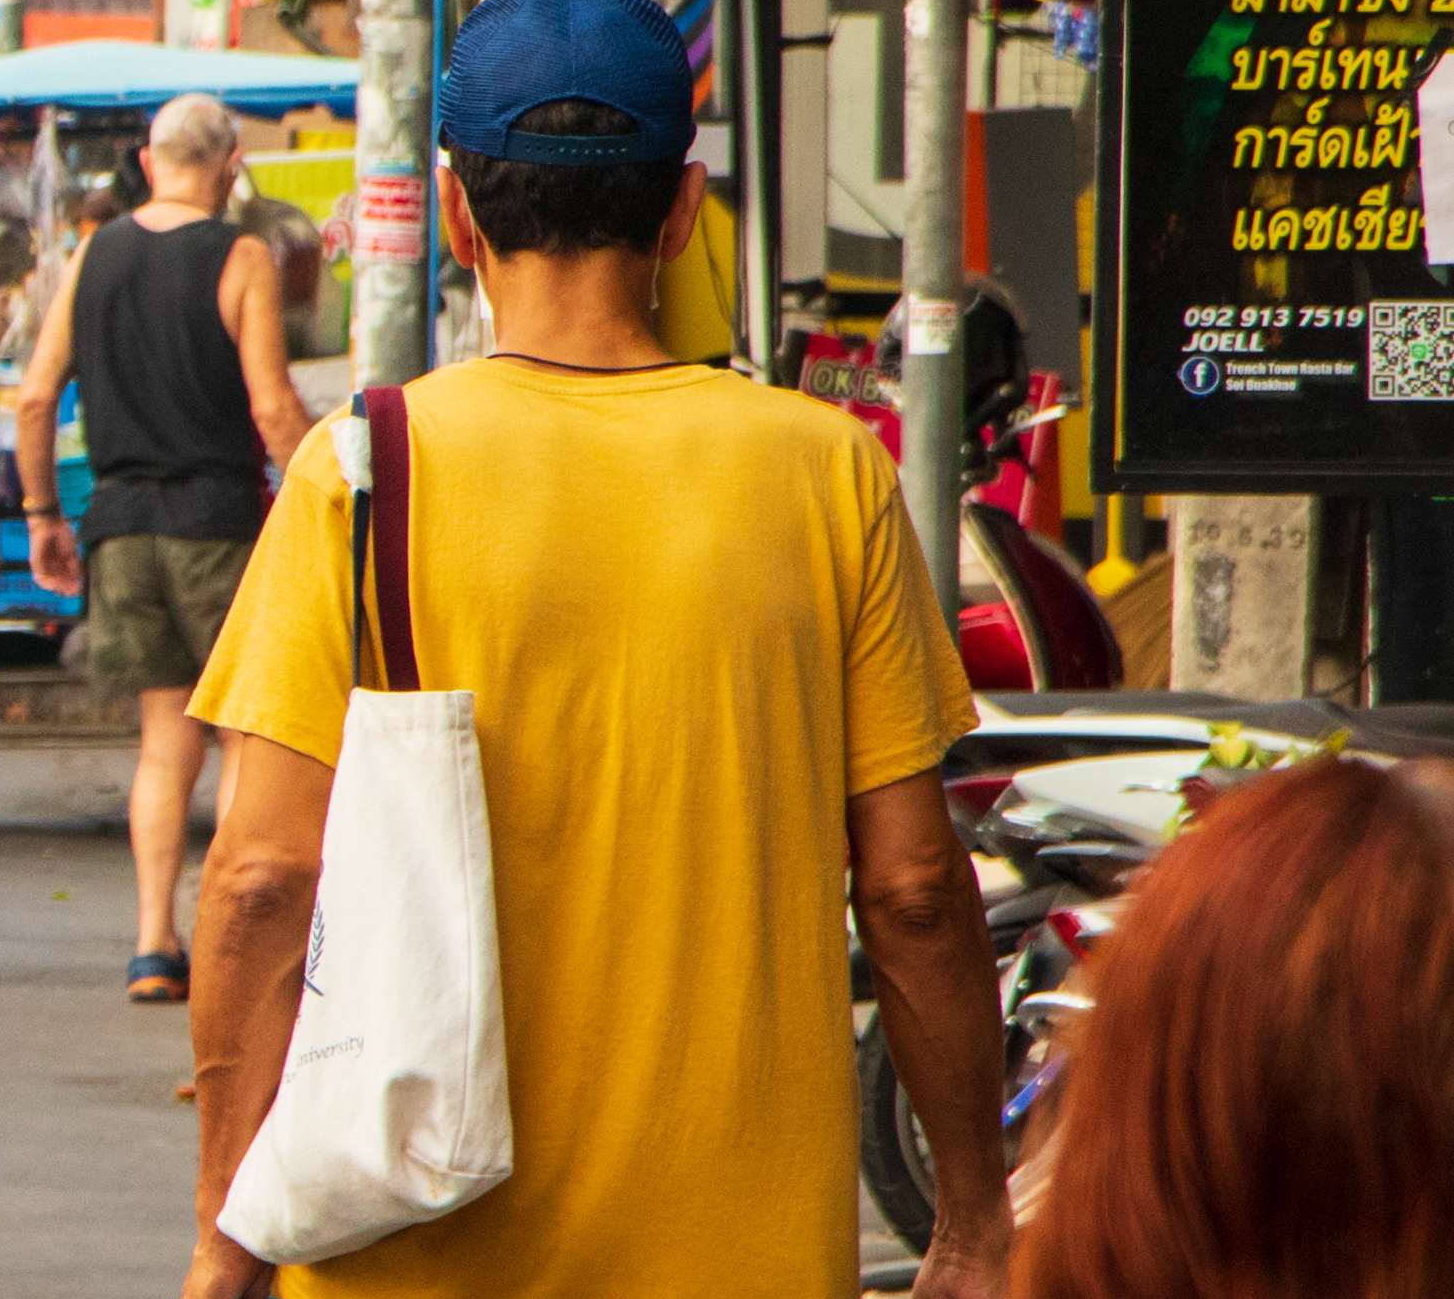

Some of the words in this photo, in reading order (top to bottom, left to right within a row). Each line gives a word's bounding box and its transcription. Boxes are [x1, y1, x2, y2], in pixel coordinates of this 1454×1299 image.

[1231, 17, 1410, 91] บาร์เทน
[1232, 95, 1422, 169] การ์ดเฝ้
[1231, 179, 1428, 251] แคชเชีย
[1183, 306, 1234, 328] 092
[1240, 306, 1290, 328] 913
[1298, 306, 1366, 328] 7519
[1181, 331, 1266, 352] JOELL
[1225, 362, 1267, 376] Trench
[1268, 362, 1299, 376] Town
[1334, 362, 1355, 376] Bar
